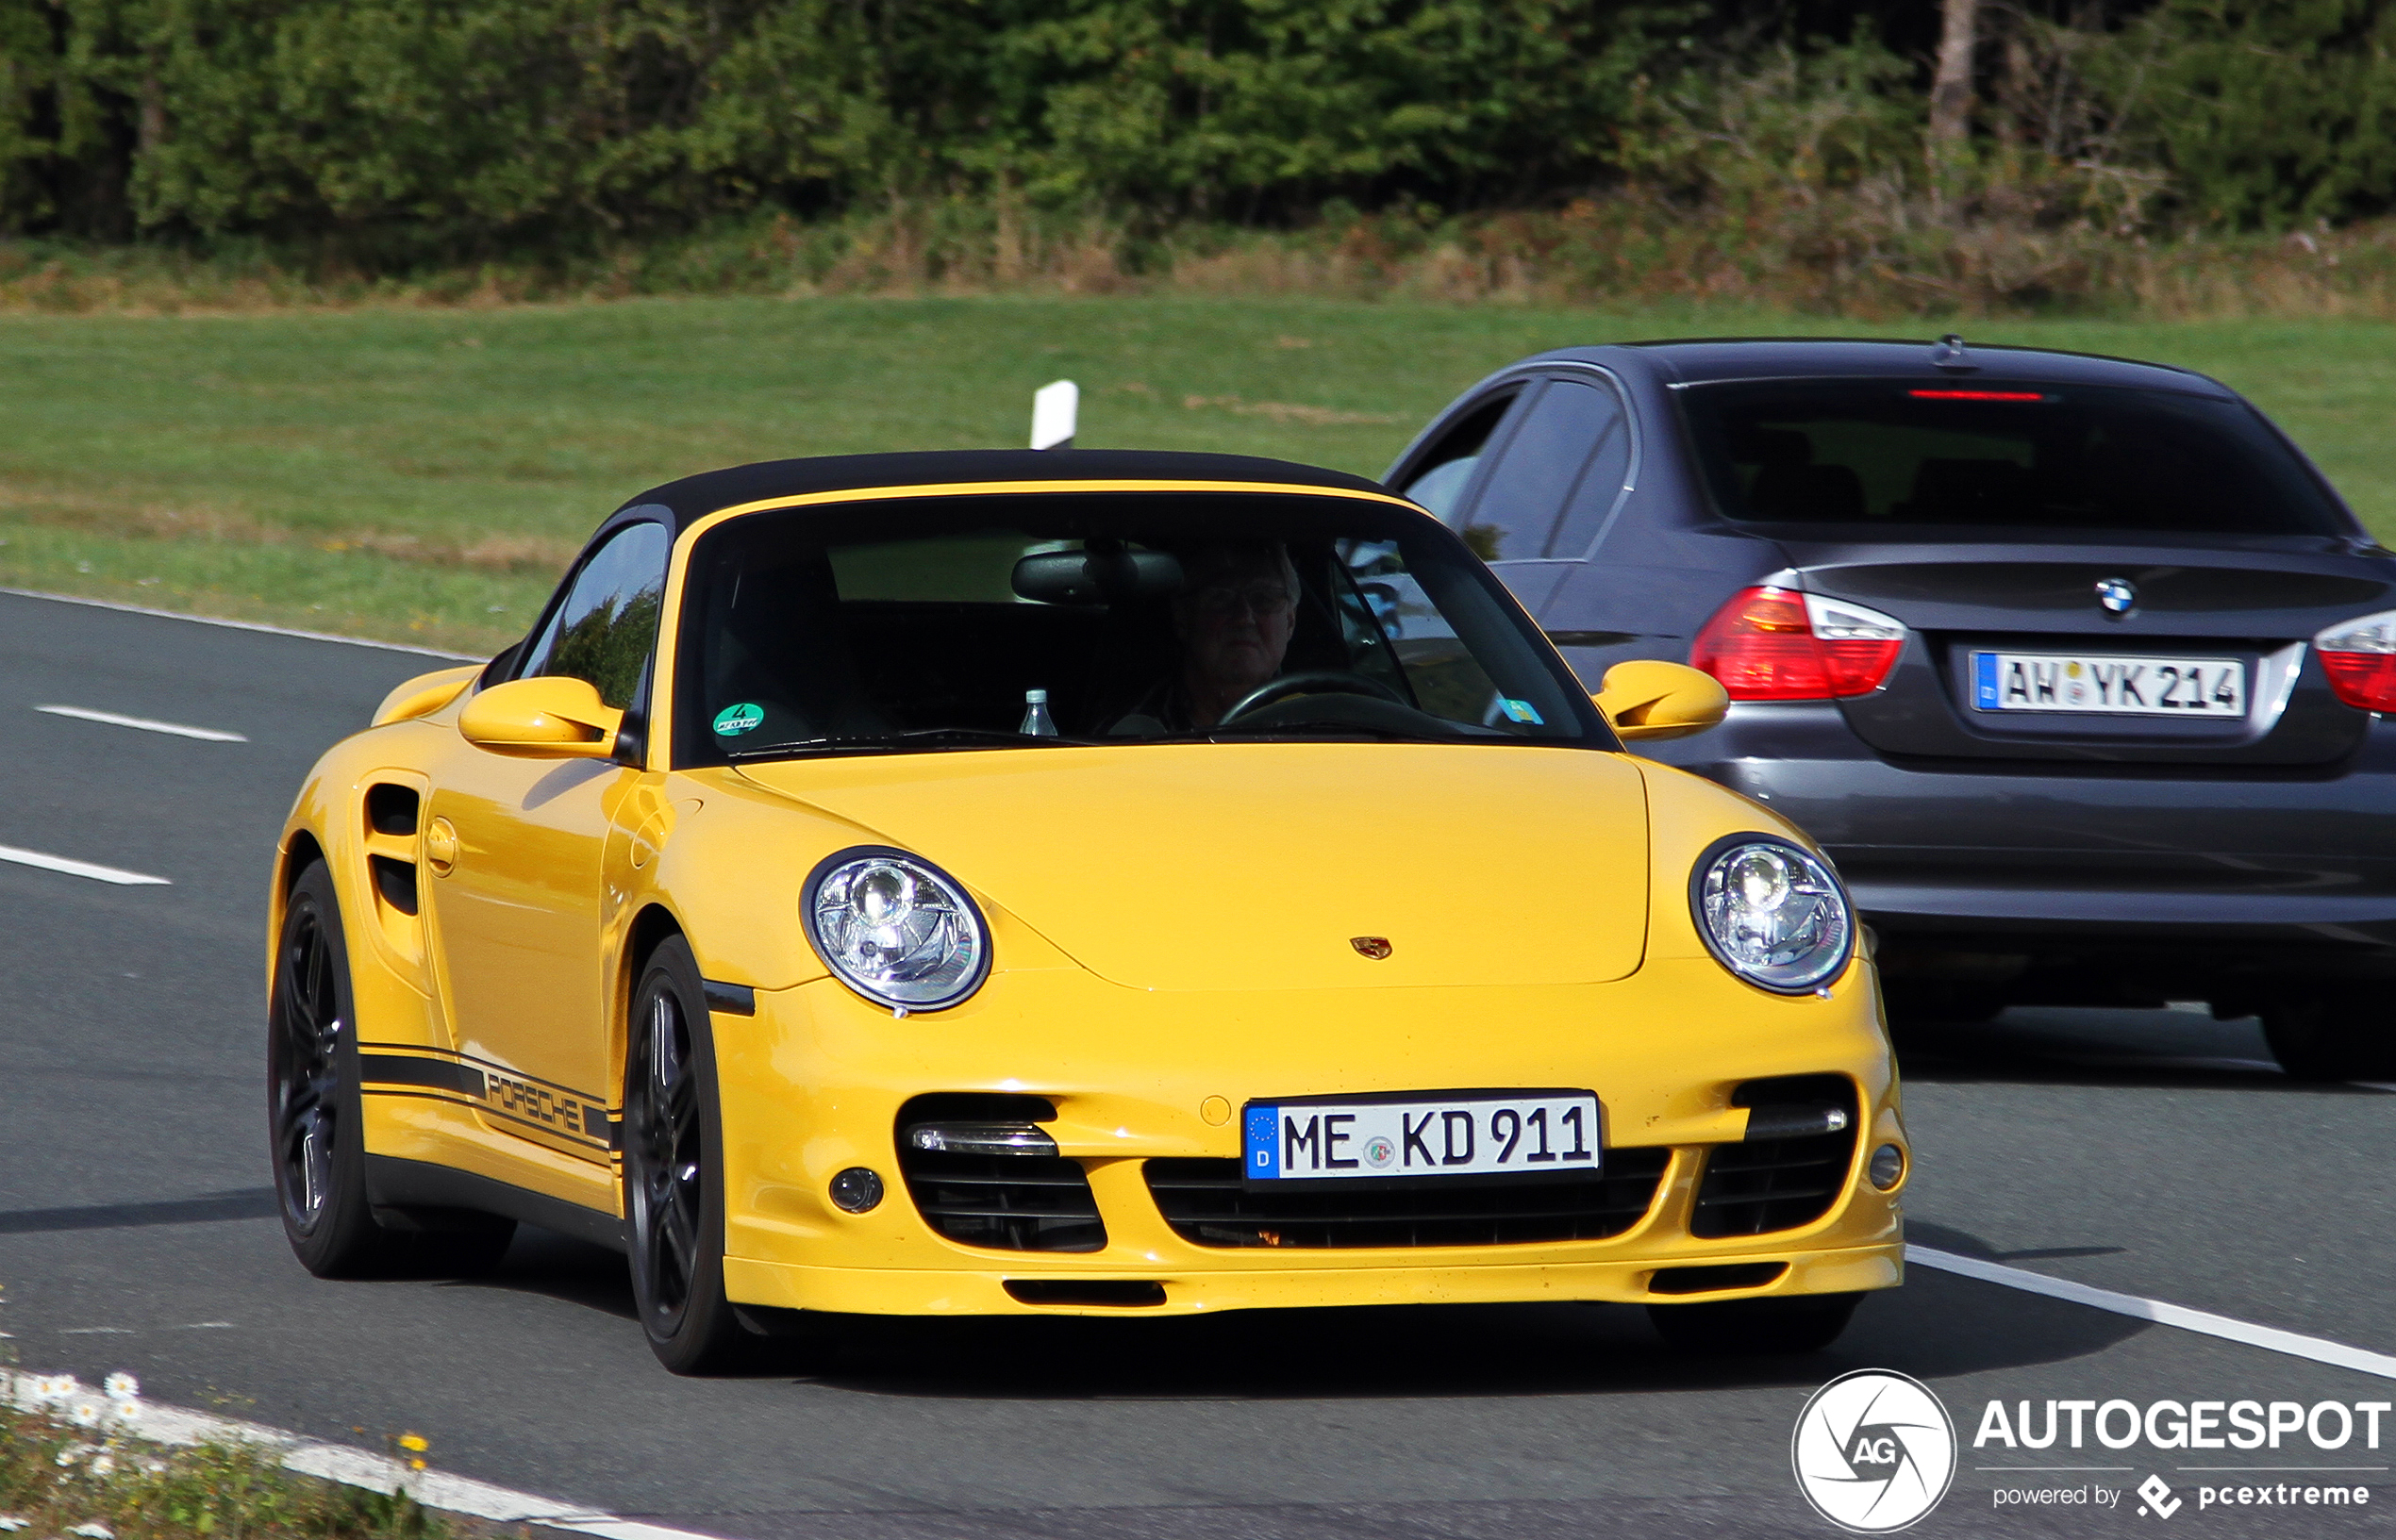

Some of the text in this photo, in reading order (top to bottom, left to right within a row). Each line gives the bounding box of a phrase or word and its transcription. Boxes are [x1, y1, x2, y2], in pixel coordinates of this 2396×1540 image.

[2007, 662, 2238, 710] AH YK 214
[732, 704, 746, 719] 4
[489, 1073, 580, 1132] PORSCHE
[1257, 1151, 1269, 1167] D
[1284, 1106, 1591, 1169] ME KD 911
